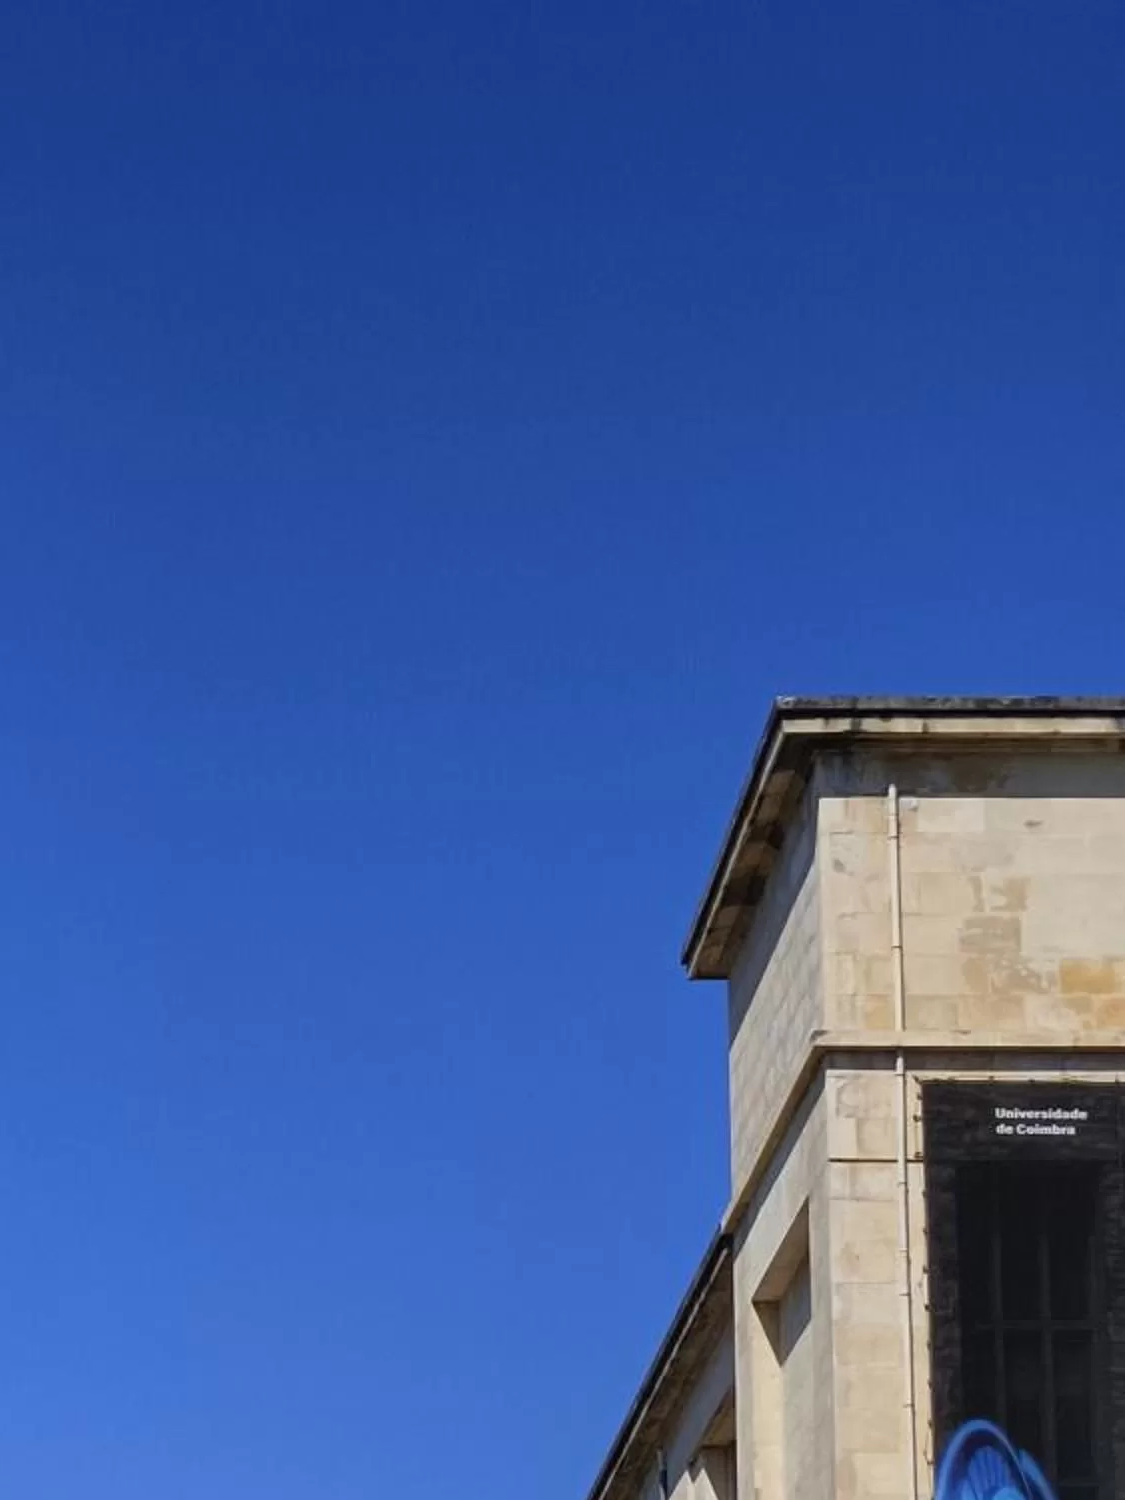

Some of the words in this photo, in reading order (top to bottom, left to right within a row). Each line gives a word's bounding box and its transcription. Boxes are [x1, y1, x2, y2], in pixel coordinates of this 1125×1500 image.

[994, 1107, 1088, 1120] Universidade
[996, 1123, 1014, 1135] de
[1016, 1123, 1076, 1135] Coimbra
